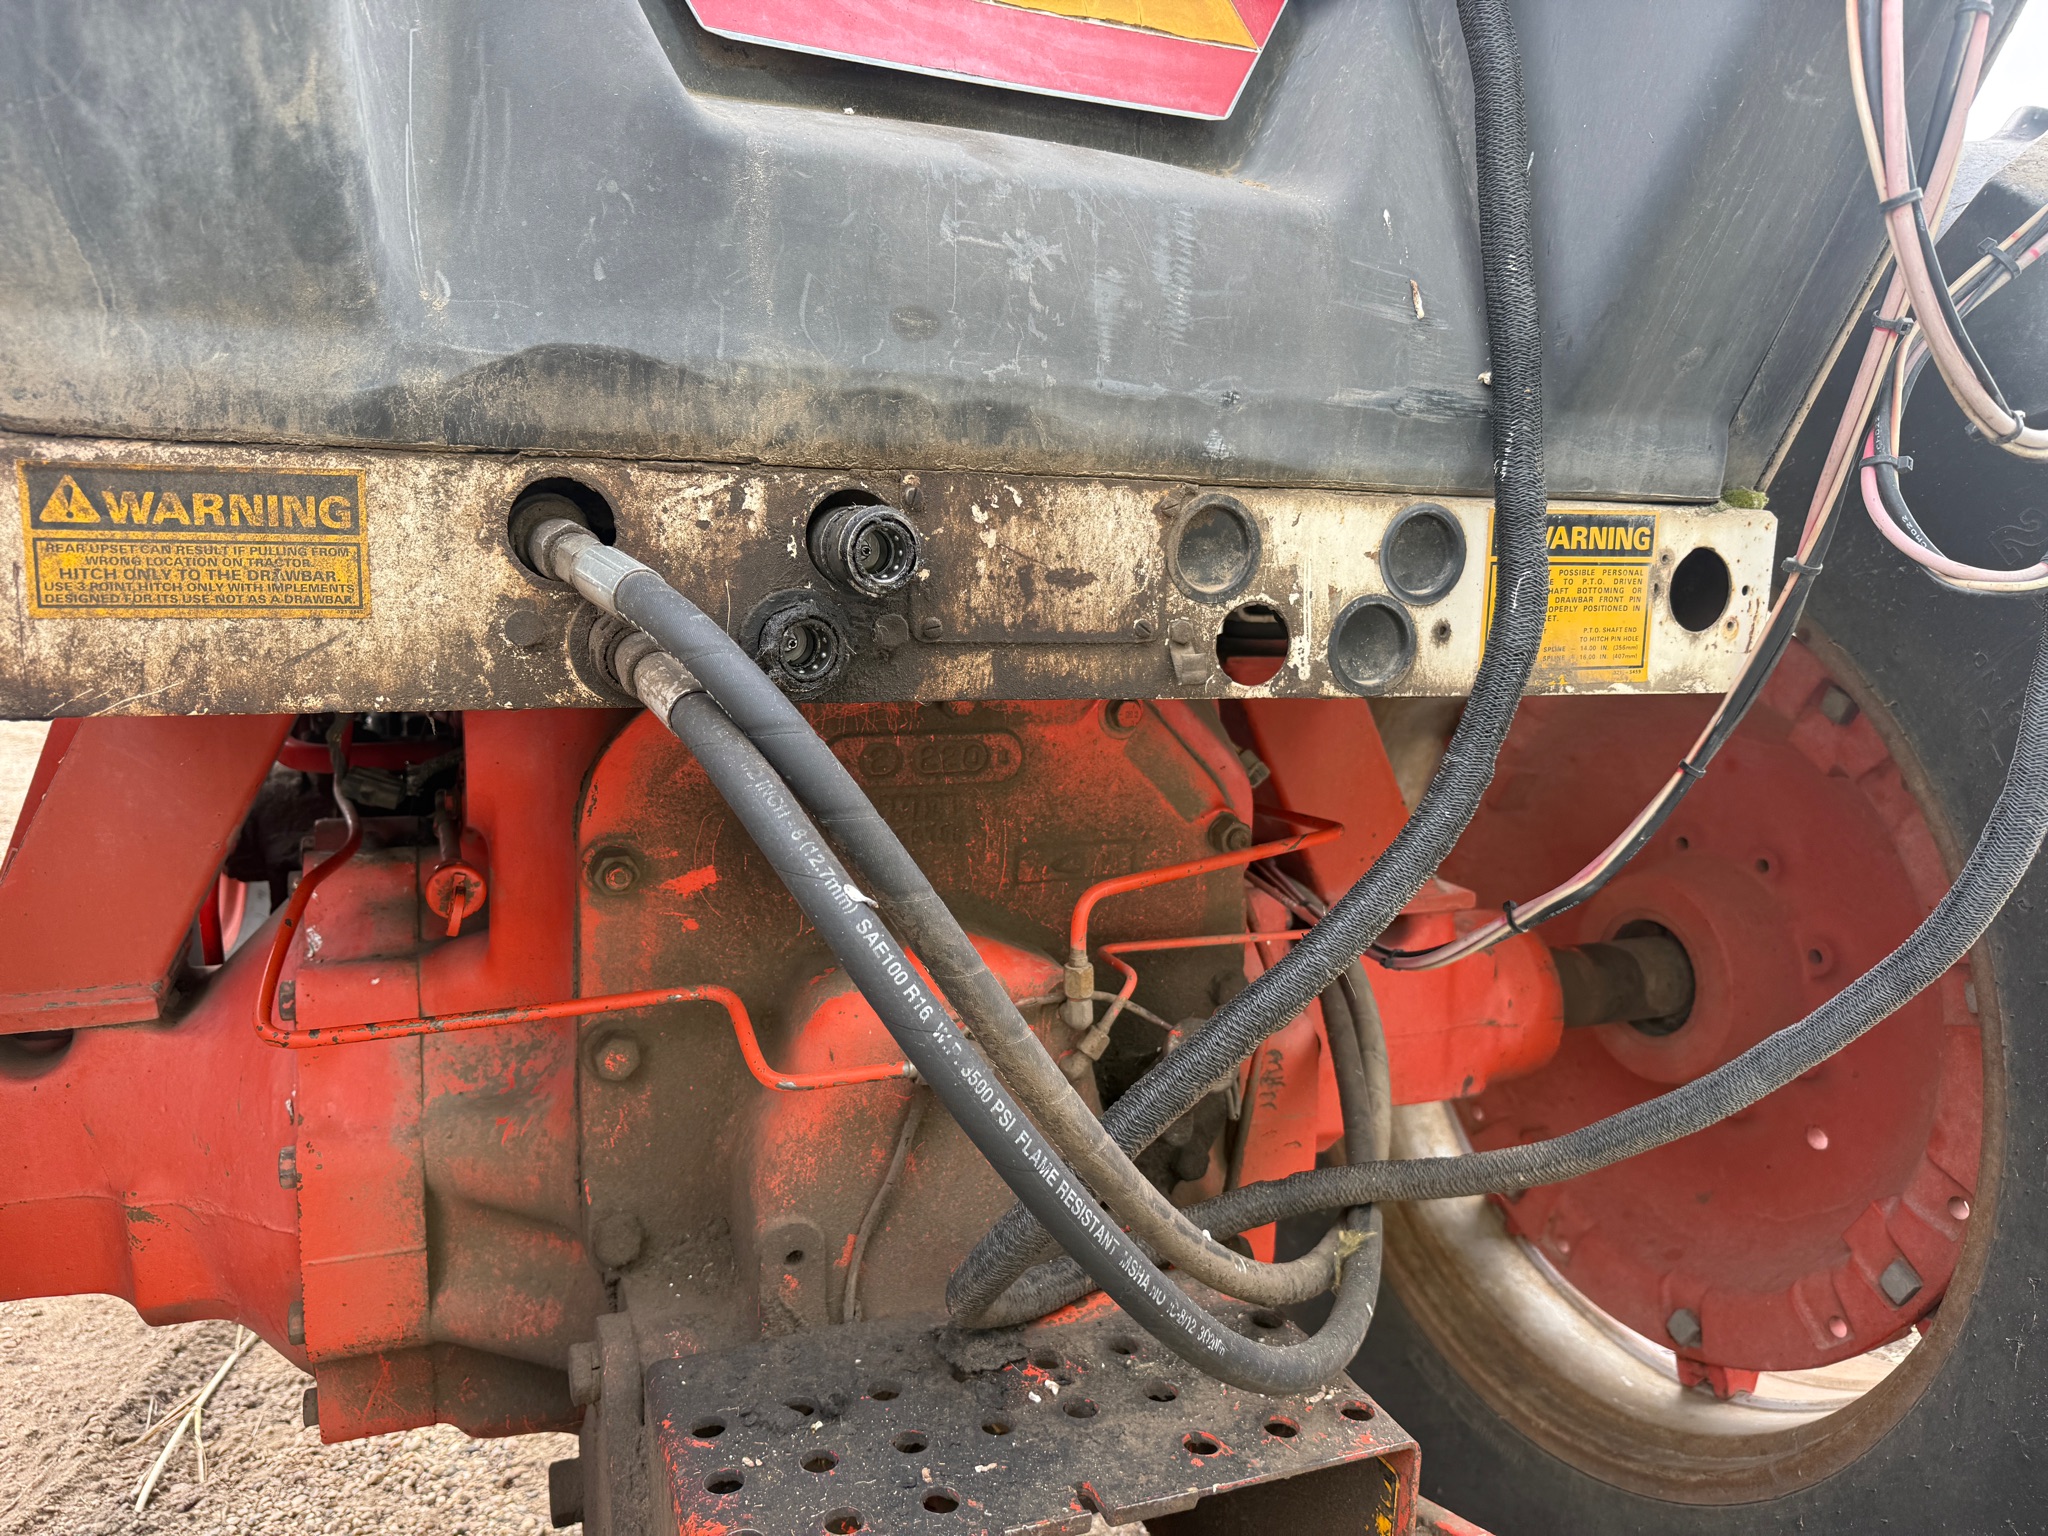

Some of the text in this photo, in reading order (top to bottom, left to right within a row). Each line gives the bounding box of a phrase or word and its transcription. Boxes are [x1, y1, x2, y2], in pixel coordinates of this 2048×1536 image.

[101, 490, 351, 529] WARNING
[45, 543, 349, 557] REAR UPSET CAN RESULT IF PULLING FROM
[86, 556, 142, 566] WRONG
[146, 557, 217, 567] LOCATION
[222, 558, 243, 567] ON
[60, 568, 341, 582] HITCH ONLY TO THE DRAWBAR.
[44, 582, 72, 592] USE
[139, 583, 183, 592] HITCH
[186, 583, 223, 593] ONLY
[228, 583, 263, 593] WITH
[267, 583, 355, 593] IMPLEMENTS
[45, 594, 356, 605] DESIGNED FOR ITS USE NOT AS A DRAWBAR.
[755, 778, 792, 819] INCH
[790, 826, 807, 842] 8
[856, 917, 909, 986] SAE100
[902, 983, 935, 1022] R16
[960, 1066, 994, 1103] 3500
[990, 1101, 1017, 1132] PSI
[1014, 1131, 1061, 1187] FLAME
[1053, 1179, 1121, 1255] RESISTANT
[1119, 1251, 1152, 1292] MSHA
